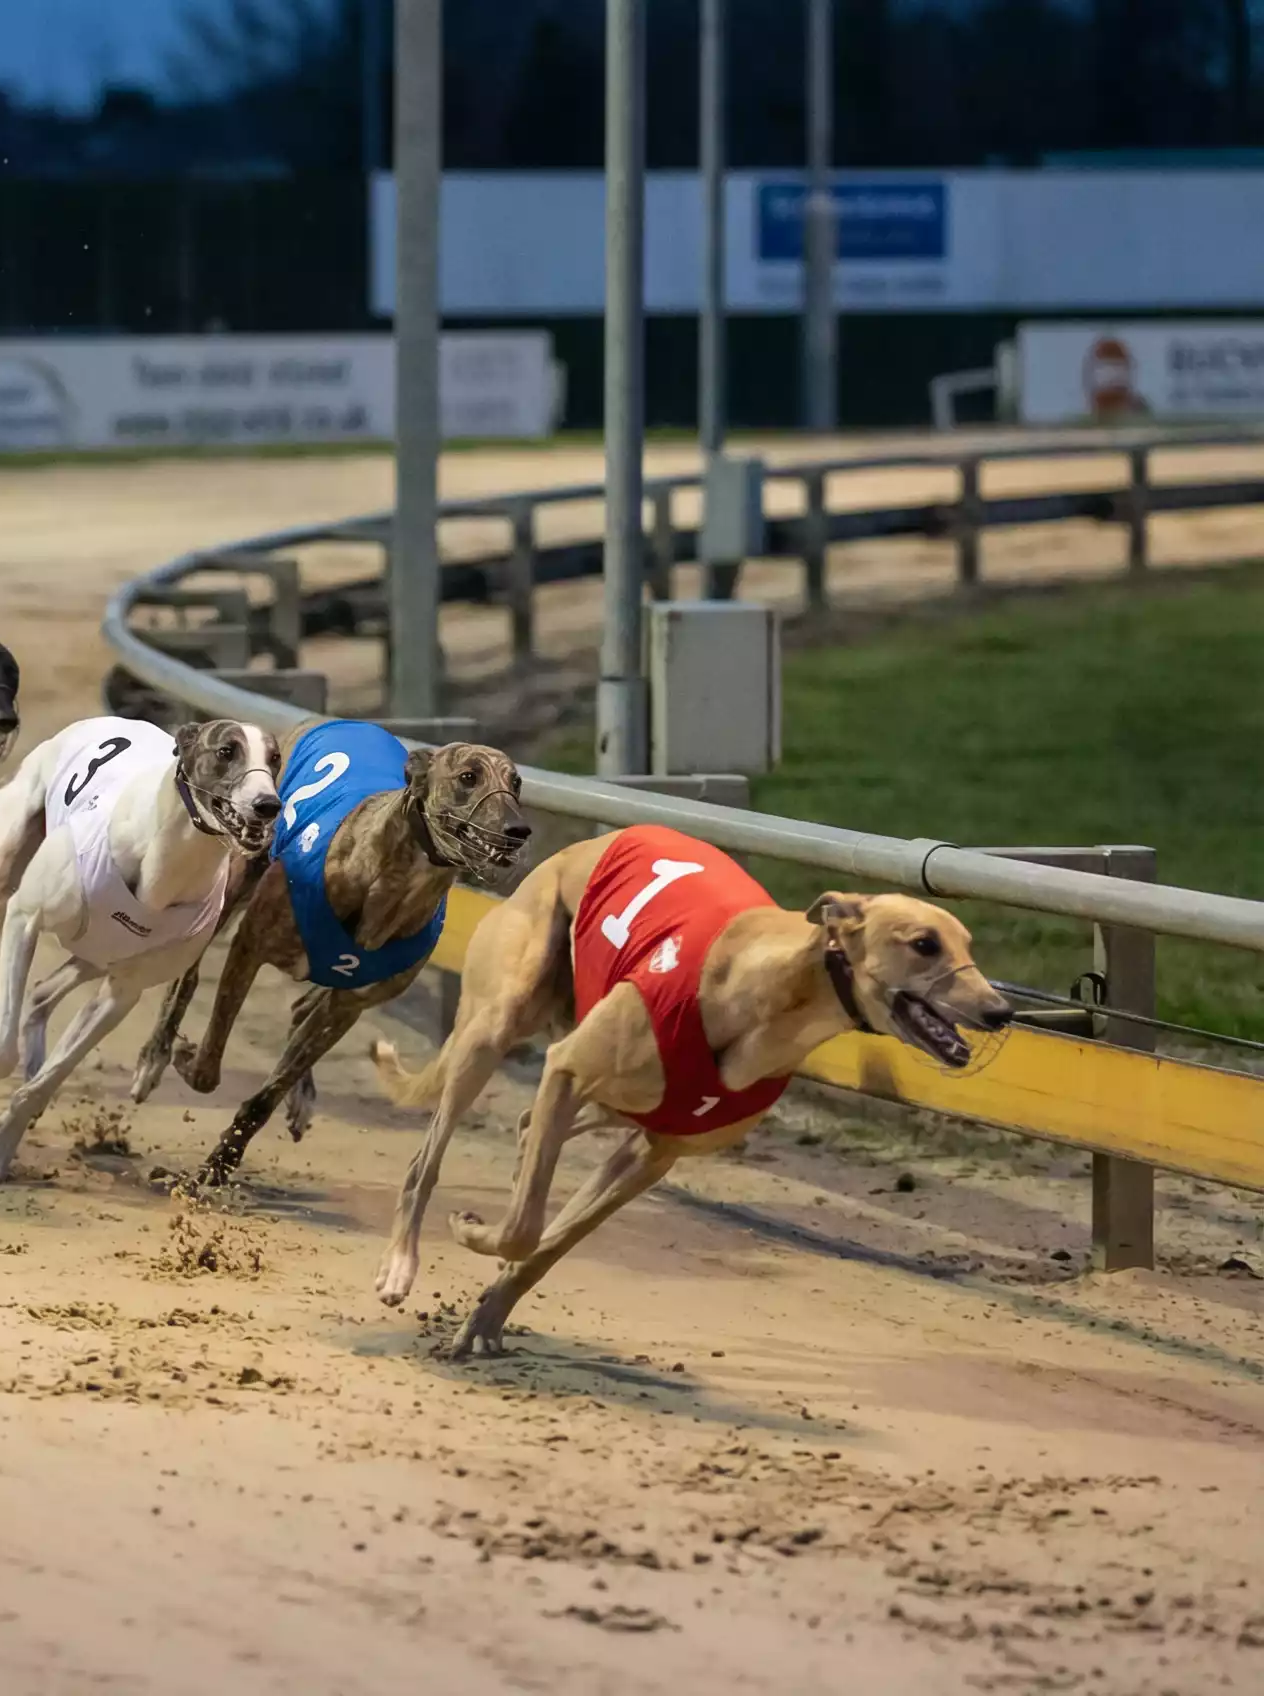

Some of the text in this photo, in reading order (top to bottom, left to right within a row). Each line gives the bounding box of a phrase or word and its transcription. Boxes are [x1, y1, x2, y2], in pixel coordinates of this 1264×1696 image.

[64, 737, 132, 807] 3
[283, 751, 351, 830] 2
[601, 859, 705, 950] 1
[331, 953, 360, 977] 2
[692, 1096, 721, 1127] 1
